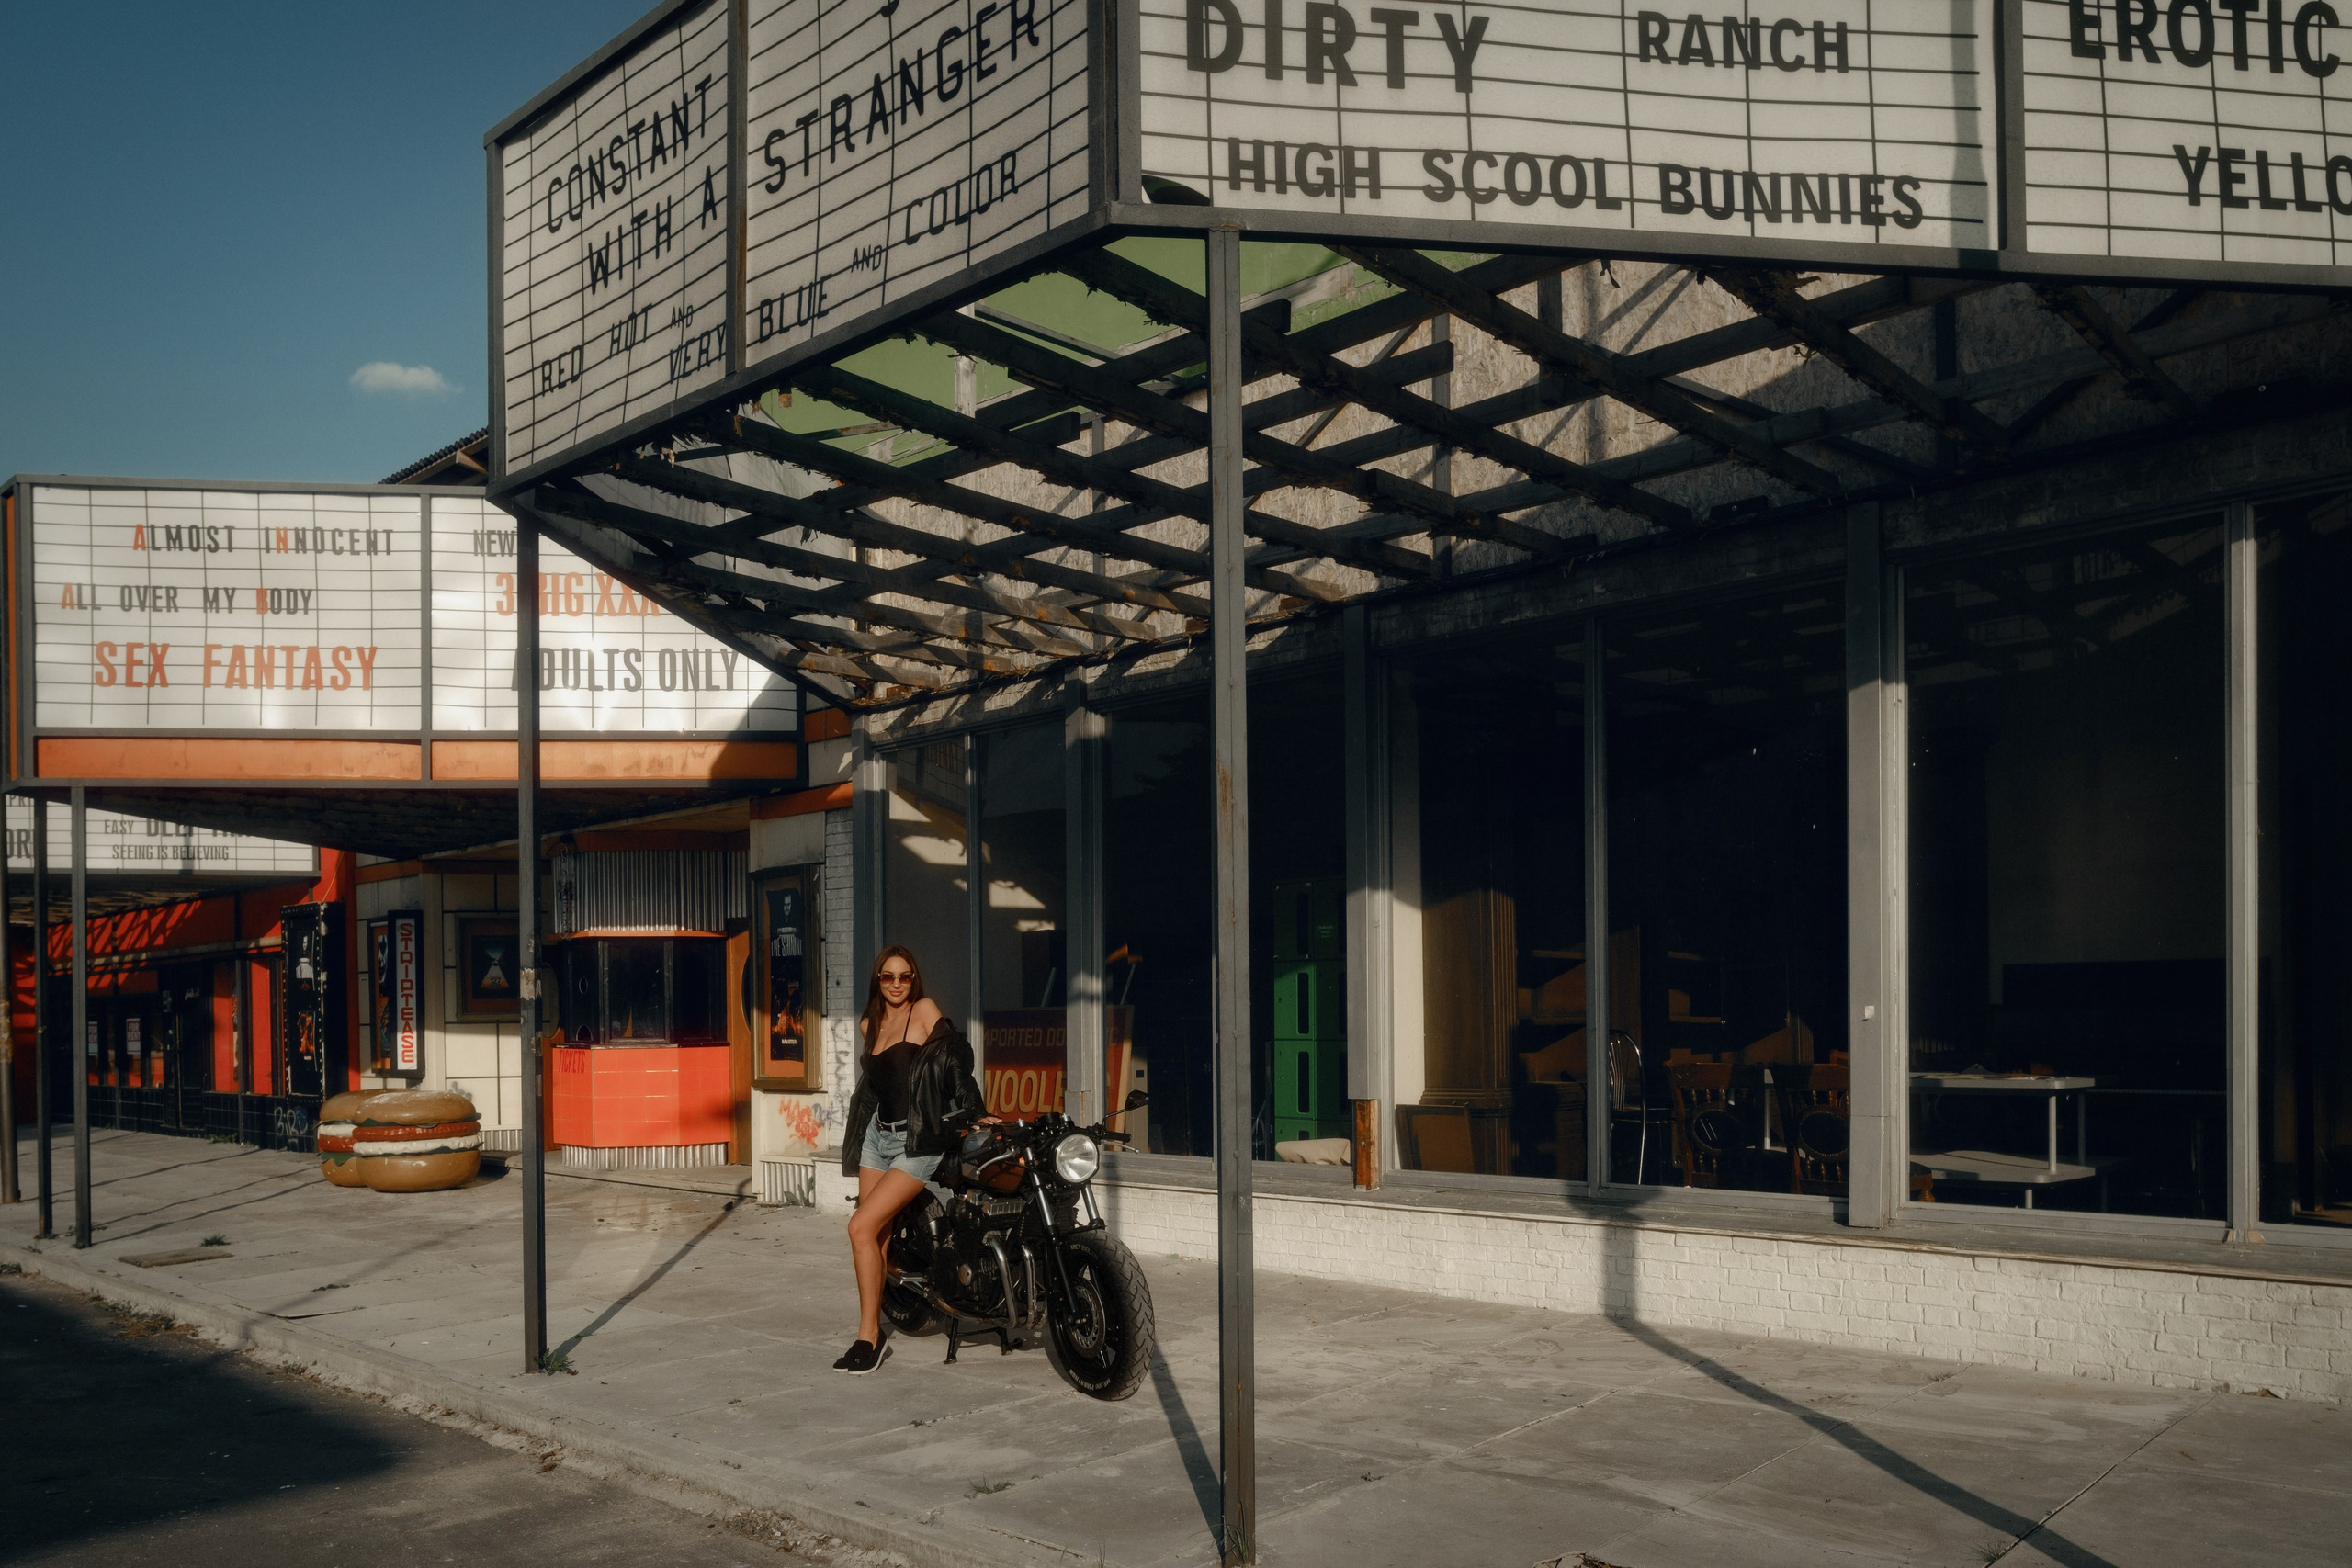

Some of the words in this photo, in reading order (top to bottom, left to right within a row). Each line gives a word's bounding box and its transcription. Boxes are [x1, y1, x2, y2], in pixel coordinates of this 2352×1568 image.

[1186, 0, 1489, 93] DIRTY
[1638, 11, 1849, 73] RANCH
[2069, 0, 2341, 78] EROTIC
[764, 0, 1040, 194] STRANGER
[548, 75, 712, 234] CONSTANT
[1227, 137, 1381, 199] HIGH
[1421, 149, 1623, 210] SCOOL
[1659, 163, 1924, 230] BUNNIES
[588, 196, 672, 295] WITH
[701, 165, 718, 231] A
[758, 273, 832, 344] BLUE
[851, 243, 883, 274] AND
[905, 150, 1020, 246] COLOR
[540, 344, 584, 398] RED
[610, 304, 653, 359] HOT
[669, 303, 695, 331] AND
[668, 321, 729, 385] VERY
[133, 524, 235, 553] ALMOST
[265, 526, 393, 556] INNOCENT
[472, 529, 515, 558] NEW
[61, 582, 101, 611] ALL
[120, 584, 179, 613] OVER
[202, 586, 236, 614] MY
[256, 587, 312, 615] BODY
[495, 572, 514, 616] 3
[95, 640, 170, 688] SEX
[203, 643, 378, 691] FANTASY
[511, 648, 642, 692] DULTS
[658, 648, 738, 692] ONLY
[104, 819, 134, 835] EASY
[112, 844, 153, 860] SEEING
[157, 845, 168, 860] IS
[172, 846, 229, 861] BELIEVING
[399, 922, 414, 1063] STRIPTEASE
[558, 1049, 586, 1074] TICKETS
